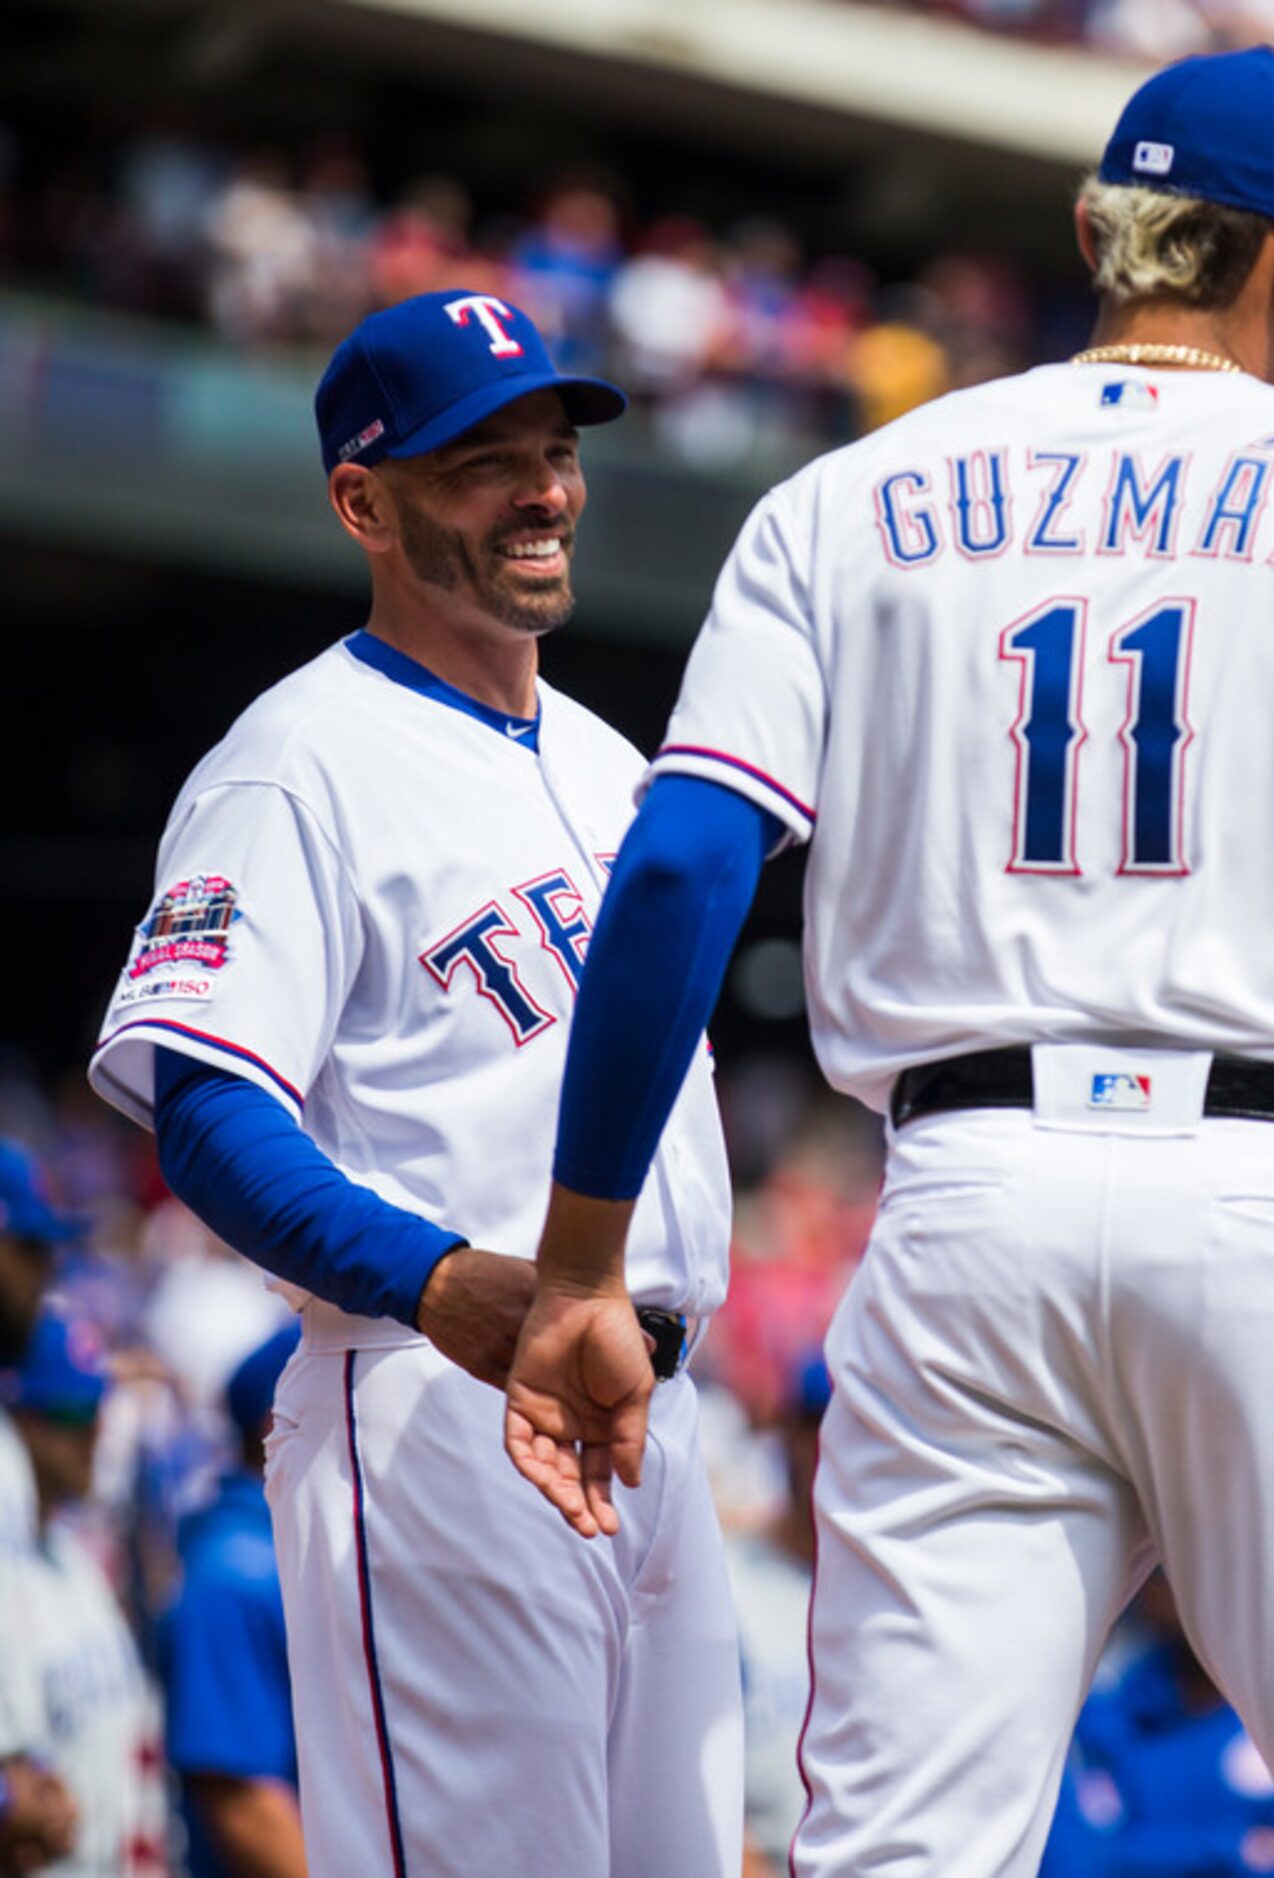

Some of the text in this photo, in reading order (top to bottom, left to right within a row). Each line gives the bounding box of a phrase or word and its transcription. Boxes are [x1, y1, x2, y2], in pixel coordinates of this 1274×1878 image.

[443, 295, 525, 359] T
[998, 596, 1197, 877] 11
[418, 852, 619, 1049] TE
